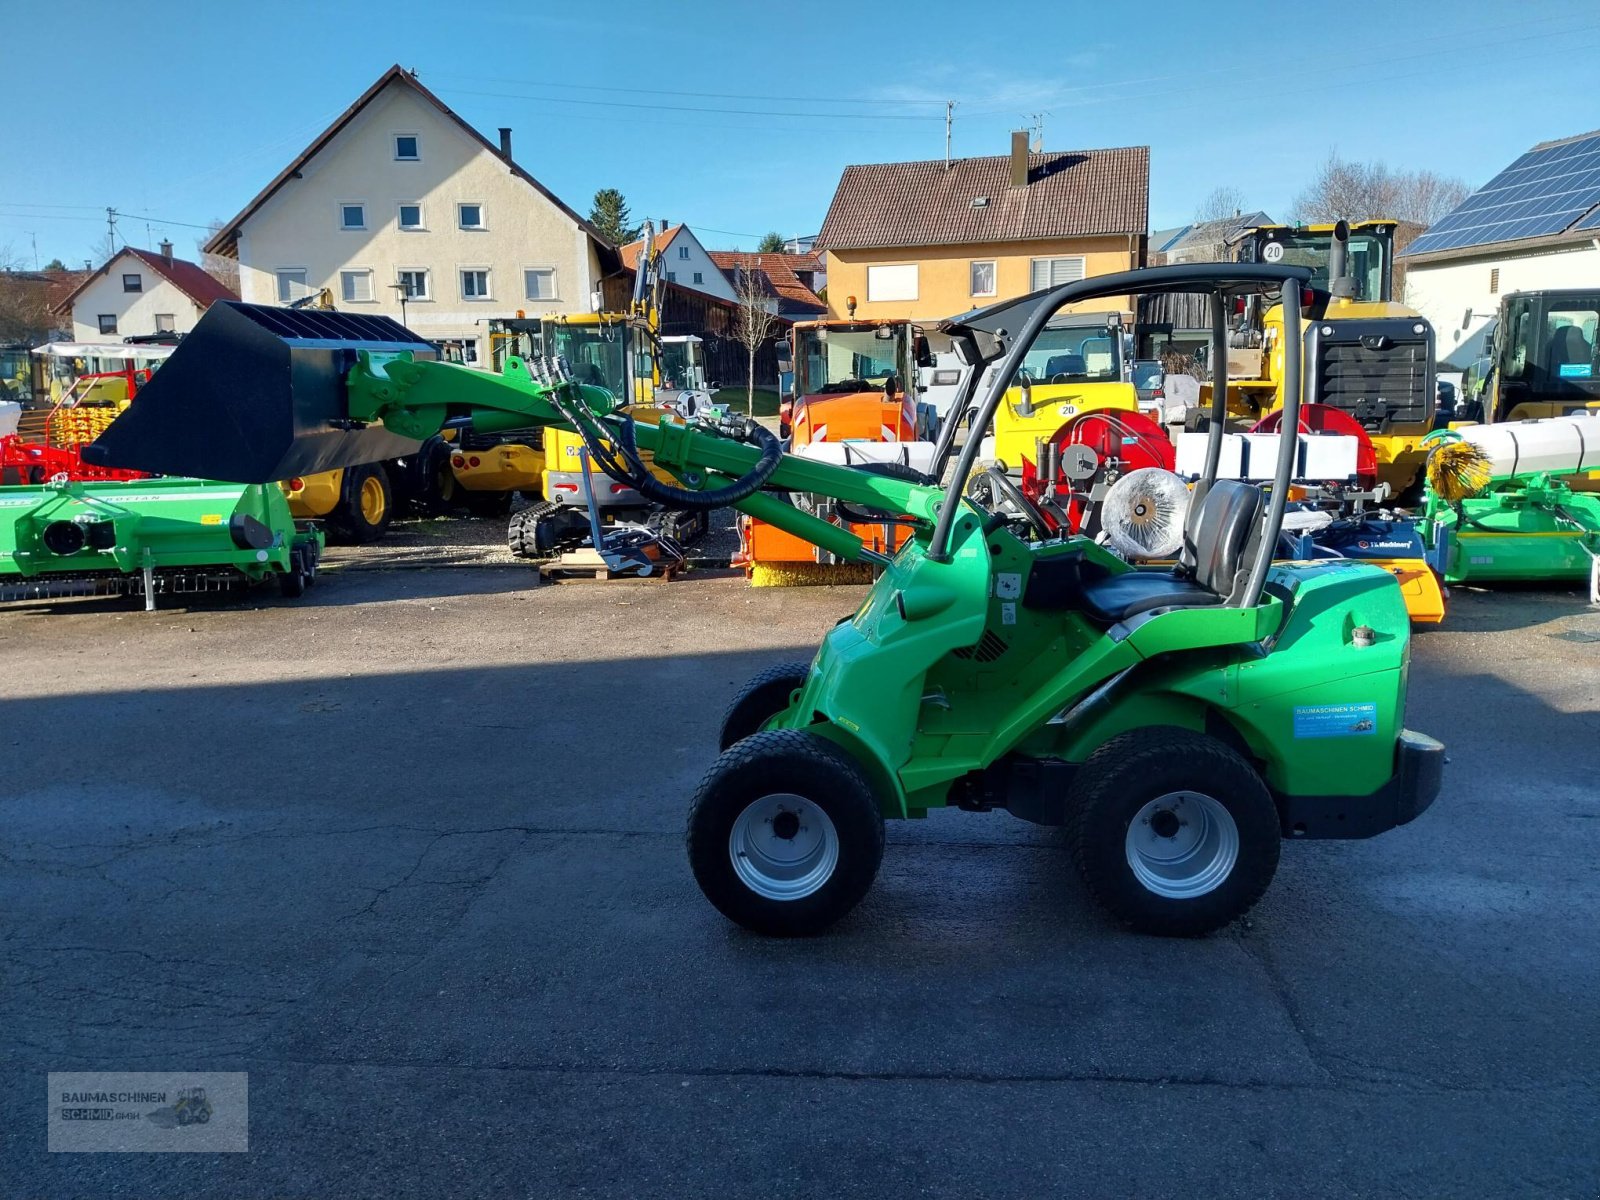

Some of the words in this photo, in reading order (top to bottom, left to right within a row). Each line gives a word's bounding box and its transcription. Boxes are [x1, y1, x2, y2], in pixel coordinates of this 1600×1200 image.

[1267, 246, 1280, 258] 20
[1062, 406, 1075, 414] 20
[1296, 706, 1348, 715] BAUMASCHINEN
[1349, 704, 1374, 713] SCHMID
